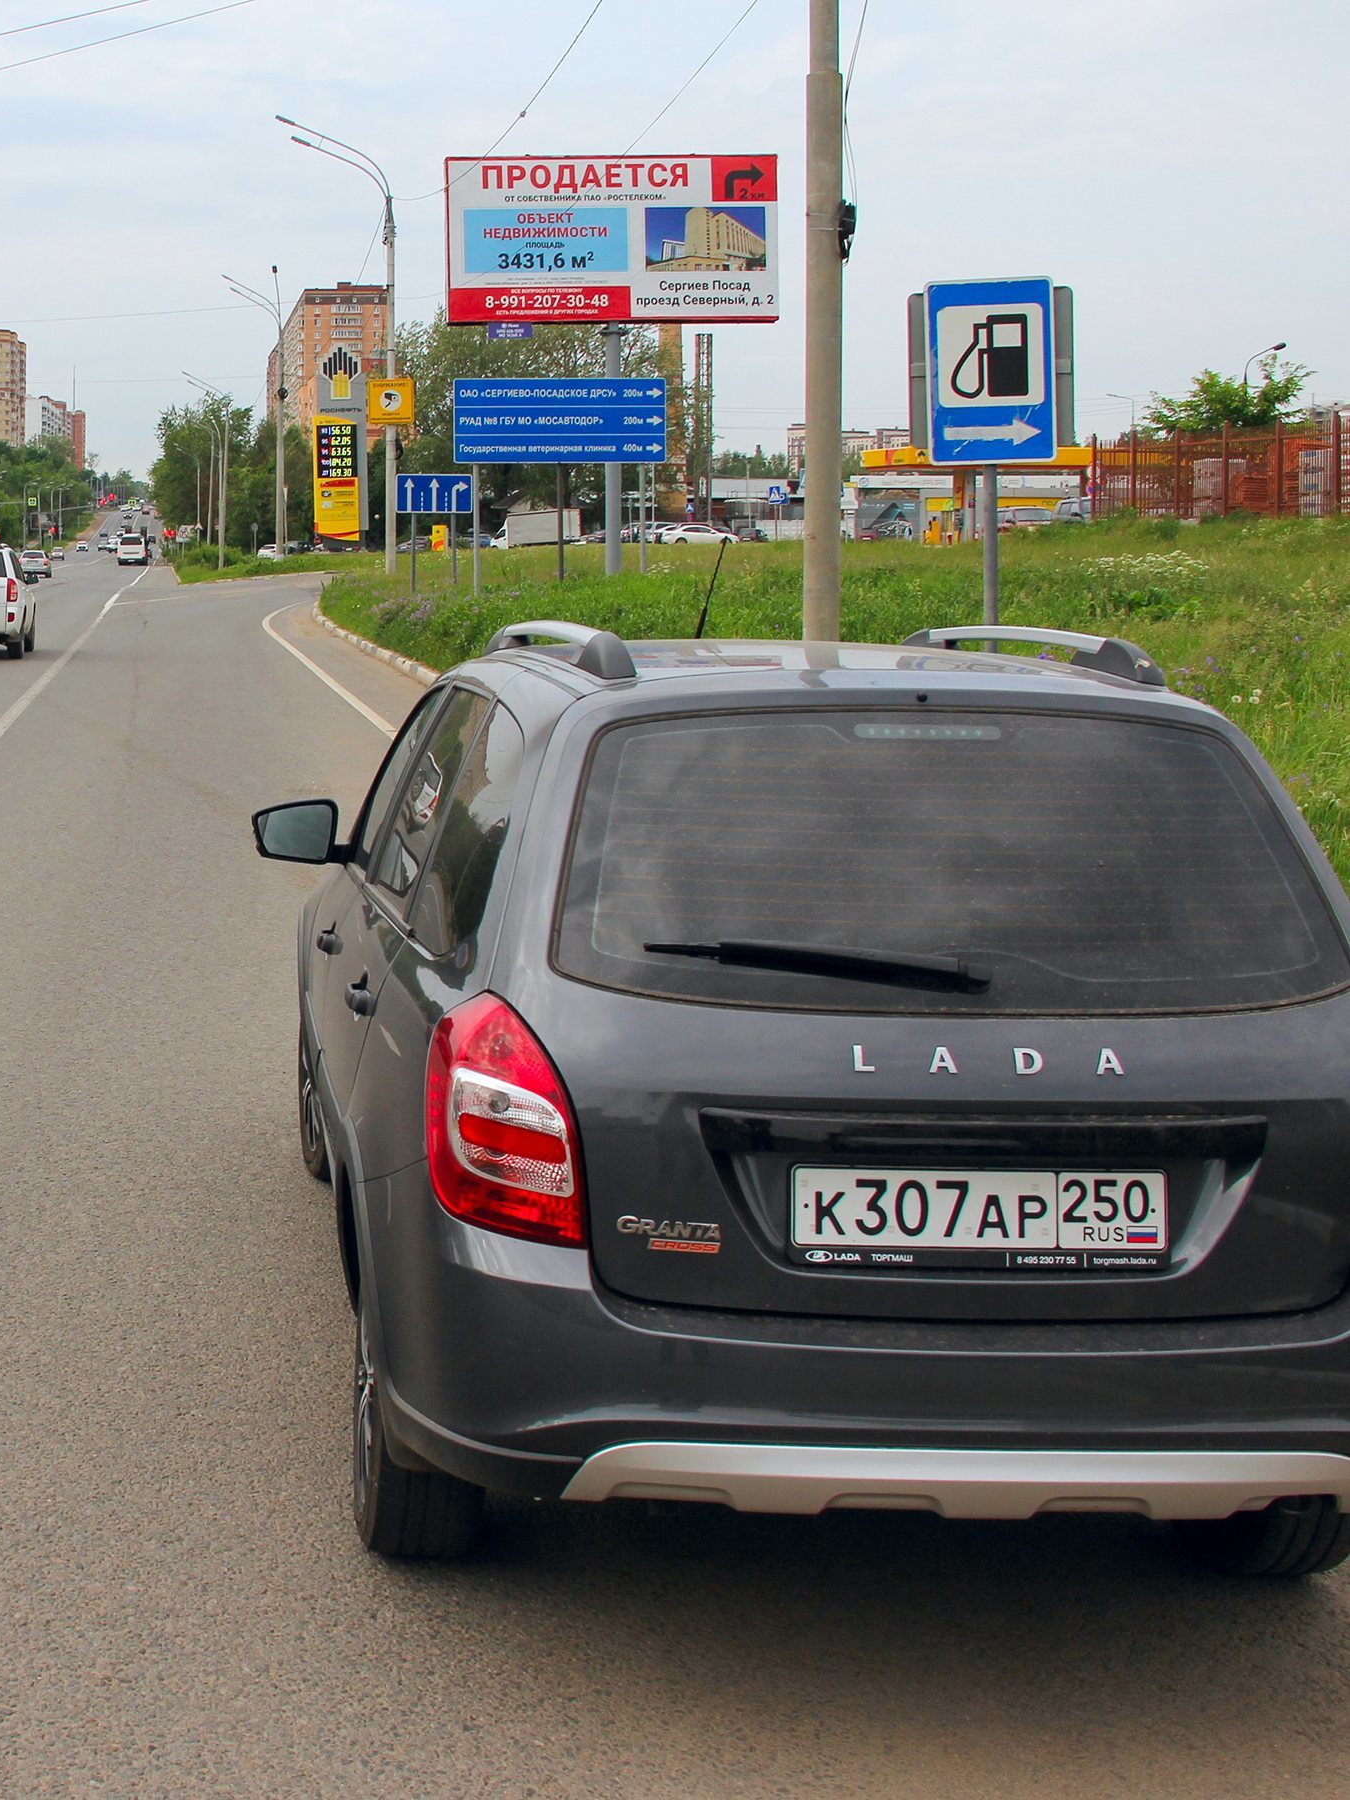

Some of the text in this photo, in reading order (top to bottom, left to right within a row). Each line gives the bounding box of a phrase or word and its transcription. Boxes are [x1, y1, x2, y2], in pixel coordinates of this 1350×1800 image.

[482, 163, 689, 194] ПРОДАЕТСЯ
[740, 188, 748, 199] 2
[517, 213, 574, 224] ОБЪЕКТ
[484, 226, 608, 240] НЕДВИЖИМОСТИ
[498, 252, 565, 272] 3431,6
[659, 280, 750, 292] Сергиев Посад
[485, 294, 609, 308] 8-991-207-30-48
[636, 294, 774, 306] проезд Северный, д. 2
[460, 390, 479, 398] ОАО
[481, 389, 588, 398] «СЕРГИЕВО-ПОСАДСКОЕ
[590, 389, 616, 398] ДРСУ»
[460, 417, 481, 426] РУАД
[500, 417, 516, 425] ГБУ
[534, 416, 604, 426] «МОСАВТОДОР»
[332, 426, 351, 435] 56.50
[332, 436, 351, 445] 62.05
[332, 448, 351, 456] 63.65
[460, 444, 526, 454] Государственная
[528, 445, 582, 454] ветеринарная
[622, 444, 642, 452] 400м
[332, 458, 352, 466] 84.20
[332, 469, 352, 477] 69.30
[852, 1044, 1125, 1075] LADA
[814, 1178, 1150, 1238] К307АР 250
[616, 1215, 722, 1240] GRANTA
[1083, 1226, 1124, 1242] RUS
[651, 1240, 717, 1252] CROSS
[834, 1252, 862, 1261] LADA
[870, 1253, 913, 1262] ТОРГМАШ
[1023, 1256, 1038, 1264] 495
[1039, 1256, 1053, 1264] 230
[1054, 1256, 1065, 1264] 77
[1066, 1256, 1076, 1264] 55
[1093, 1256, 1156, 1266] torgmash.lada.ru
